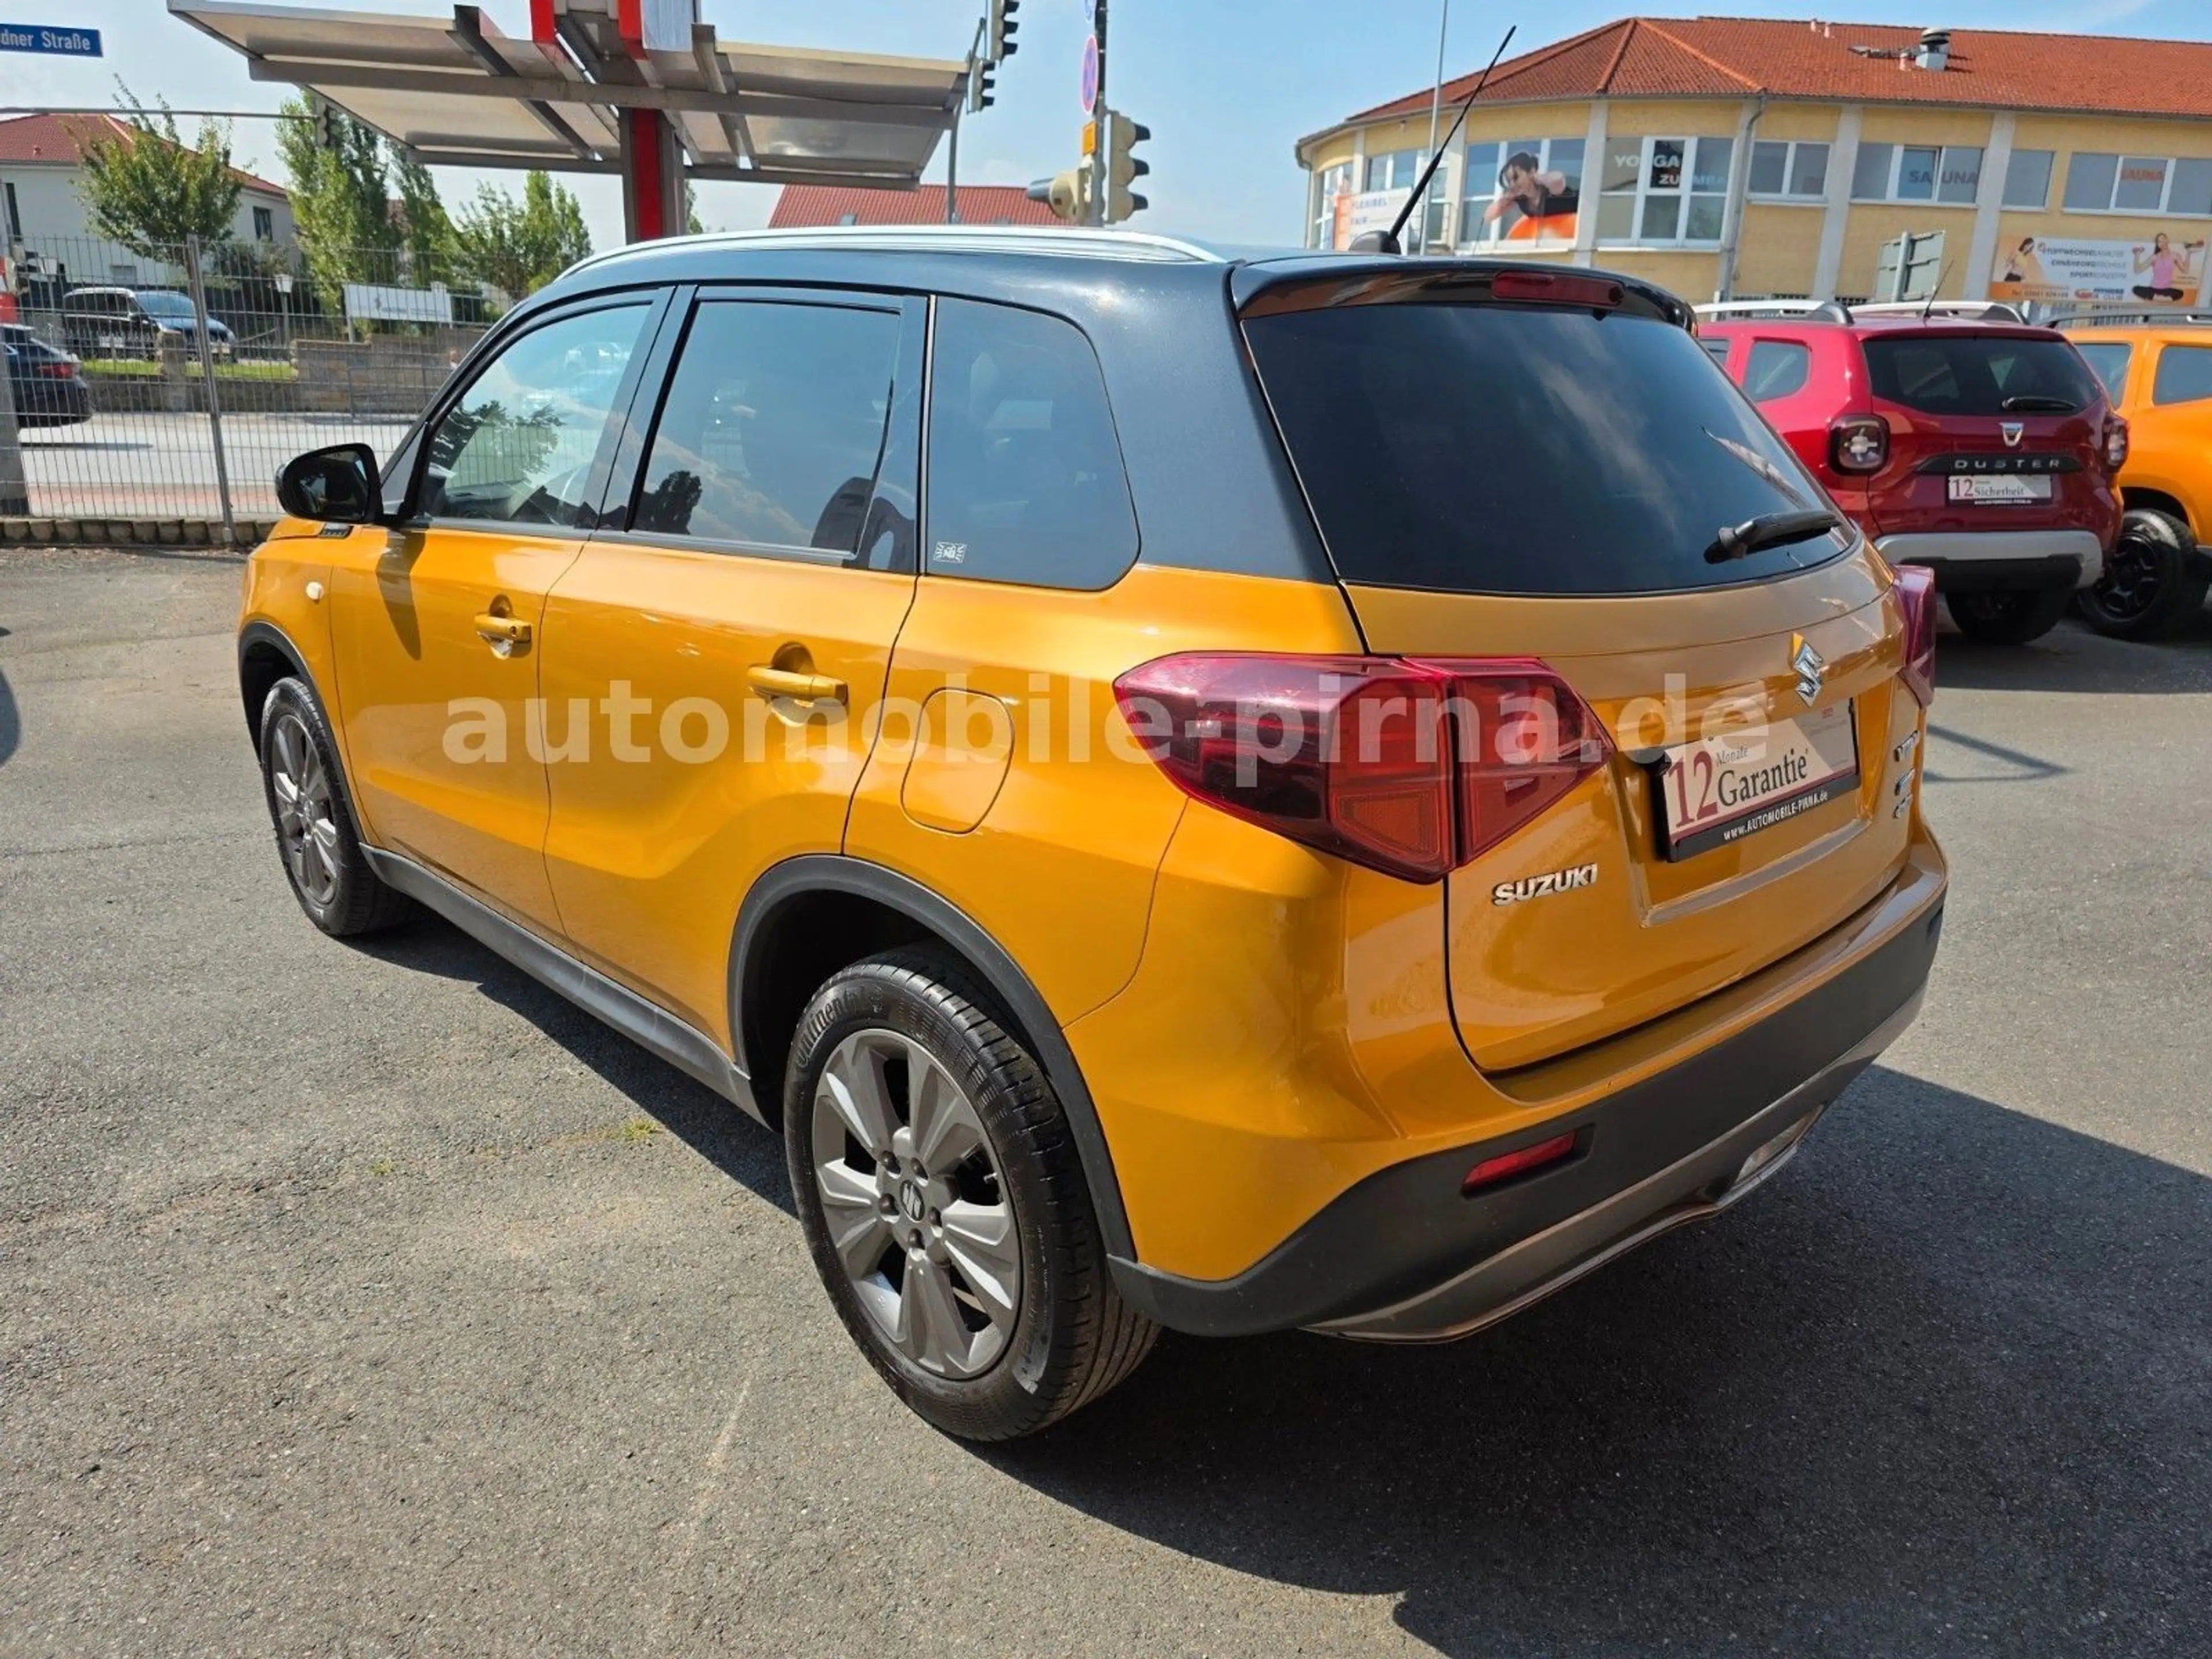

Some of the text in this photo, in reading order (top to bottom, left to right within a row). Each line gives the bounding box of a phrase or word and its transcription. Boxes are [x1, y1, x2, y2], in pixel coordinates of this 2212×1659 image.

[0, 29, 91, 51] dner Straße
[1614, 154, 1681, 168] YOGA
[1908, 170, 1980, 185] SAUNA
[1954, 459, 2060, 469] DUSTER
[1952, 478, 1974, 498] 12
[1715, 746, 1749, 768] Monate
[1667, 751, 1719, 828] 12
[1491, 862, 1599, 907] SUZUKI
